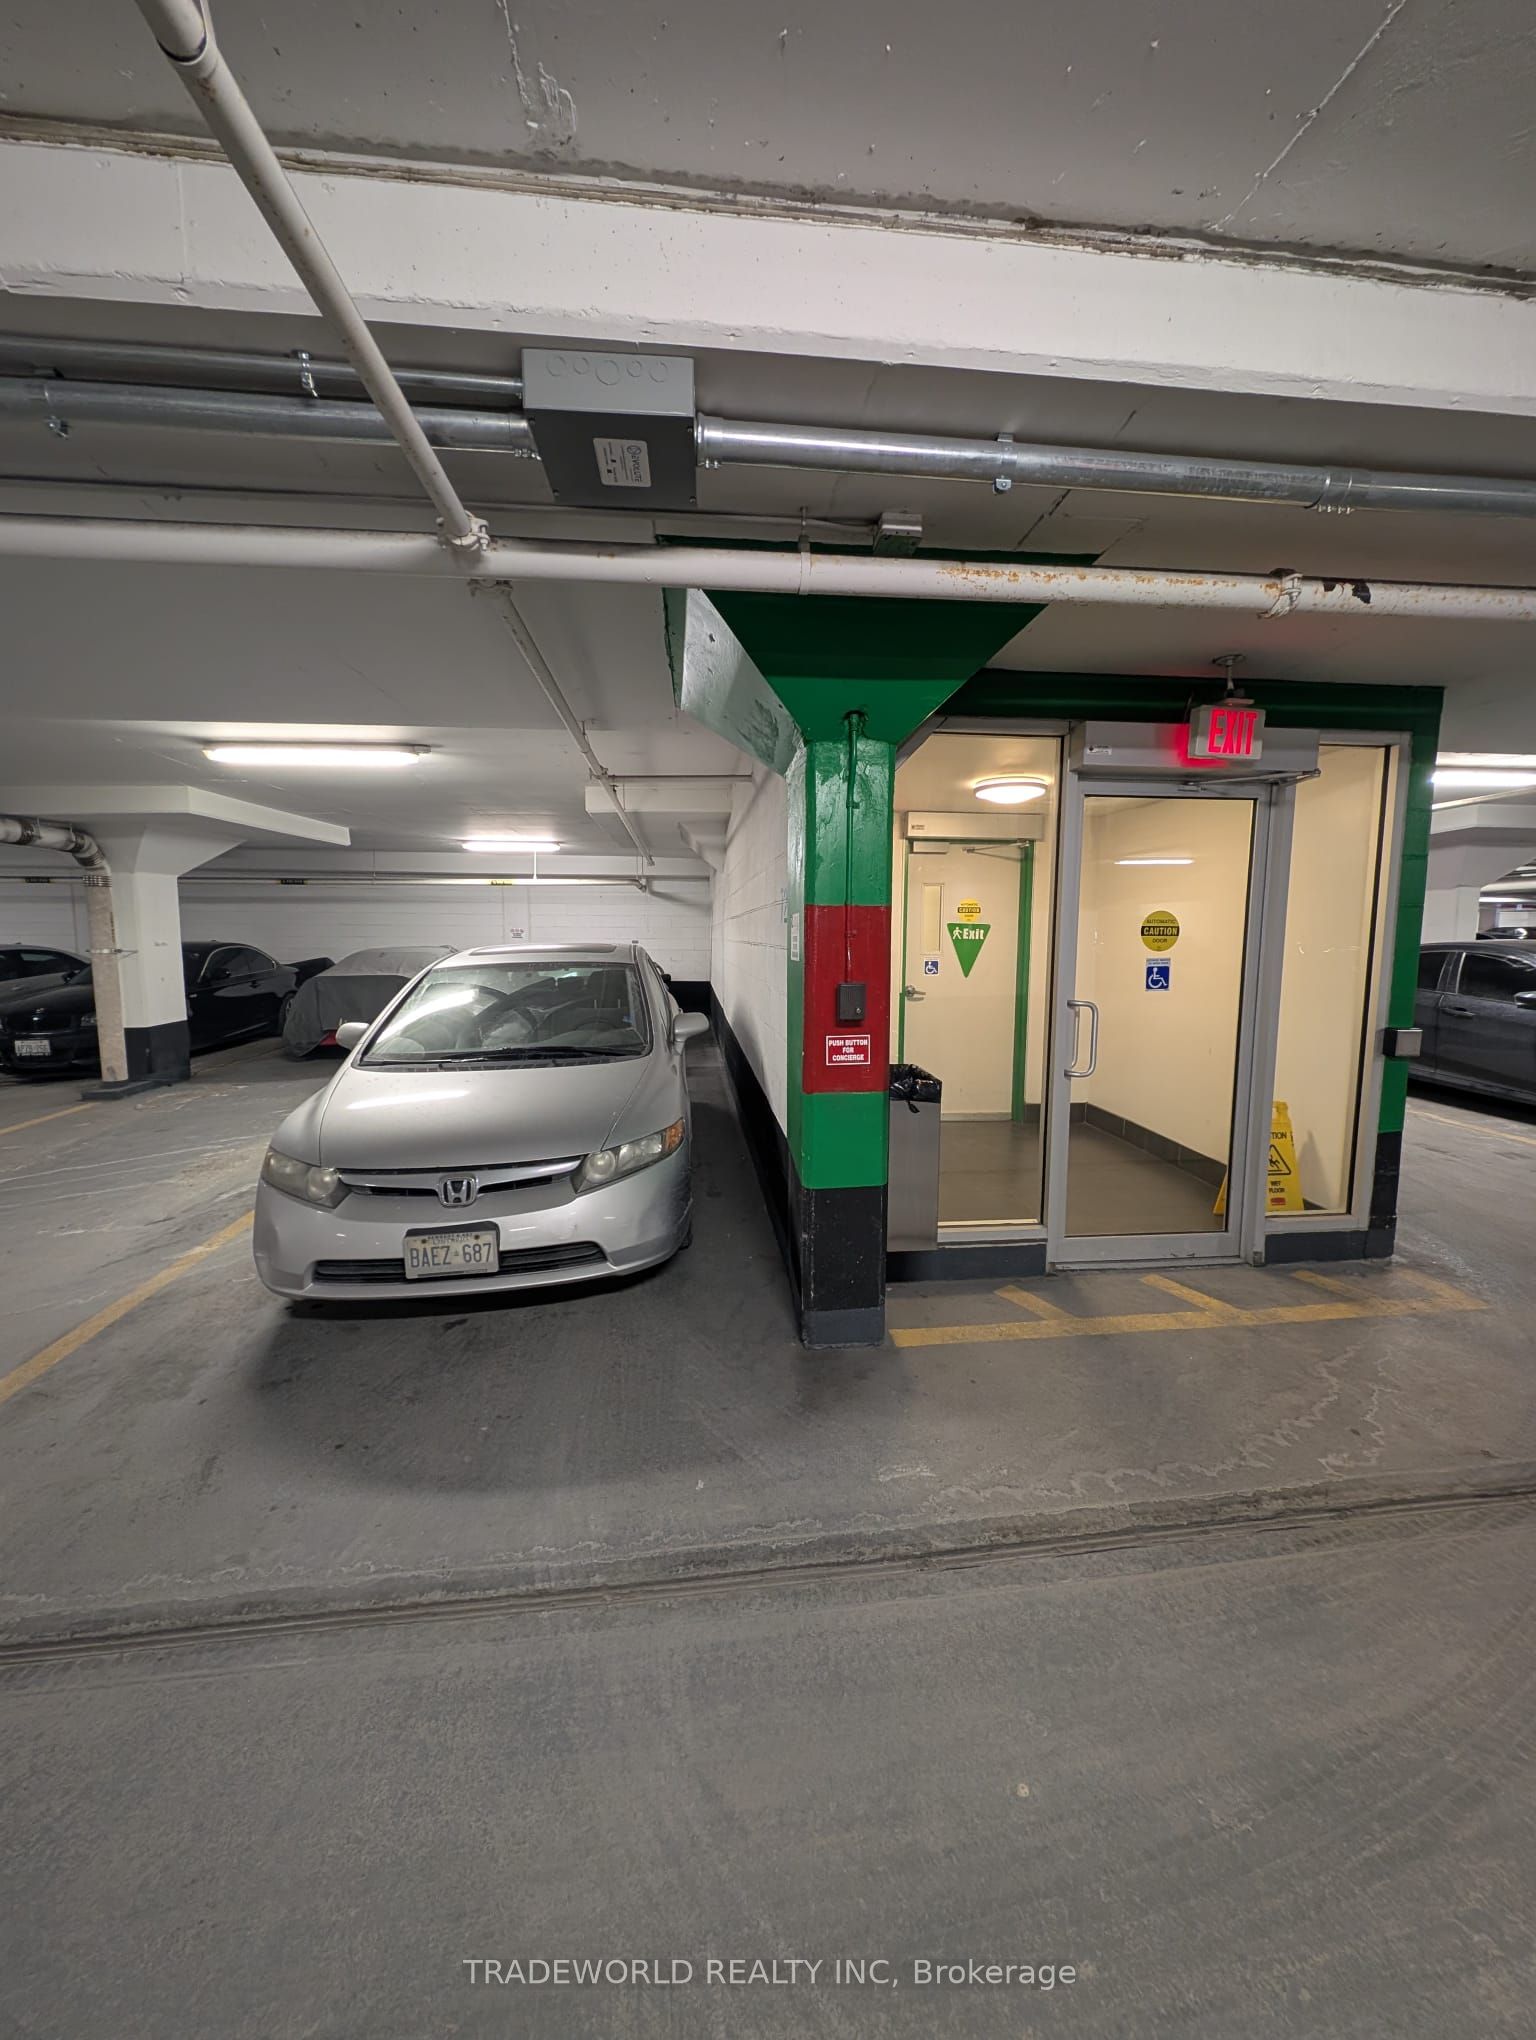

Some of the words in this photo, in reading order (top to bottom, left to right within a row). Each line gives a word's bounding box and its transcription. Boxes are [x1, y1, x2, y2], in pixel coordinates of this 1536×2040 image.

[1208, 708, 1258, 755] EXIT
[962, 928, 985, 940] Exit
[1143, 927, 1178, 936] CAUTION
[409, 1246, 451, 1268] BAEZ
[462, 1243, 491, 1263] 687
